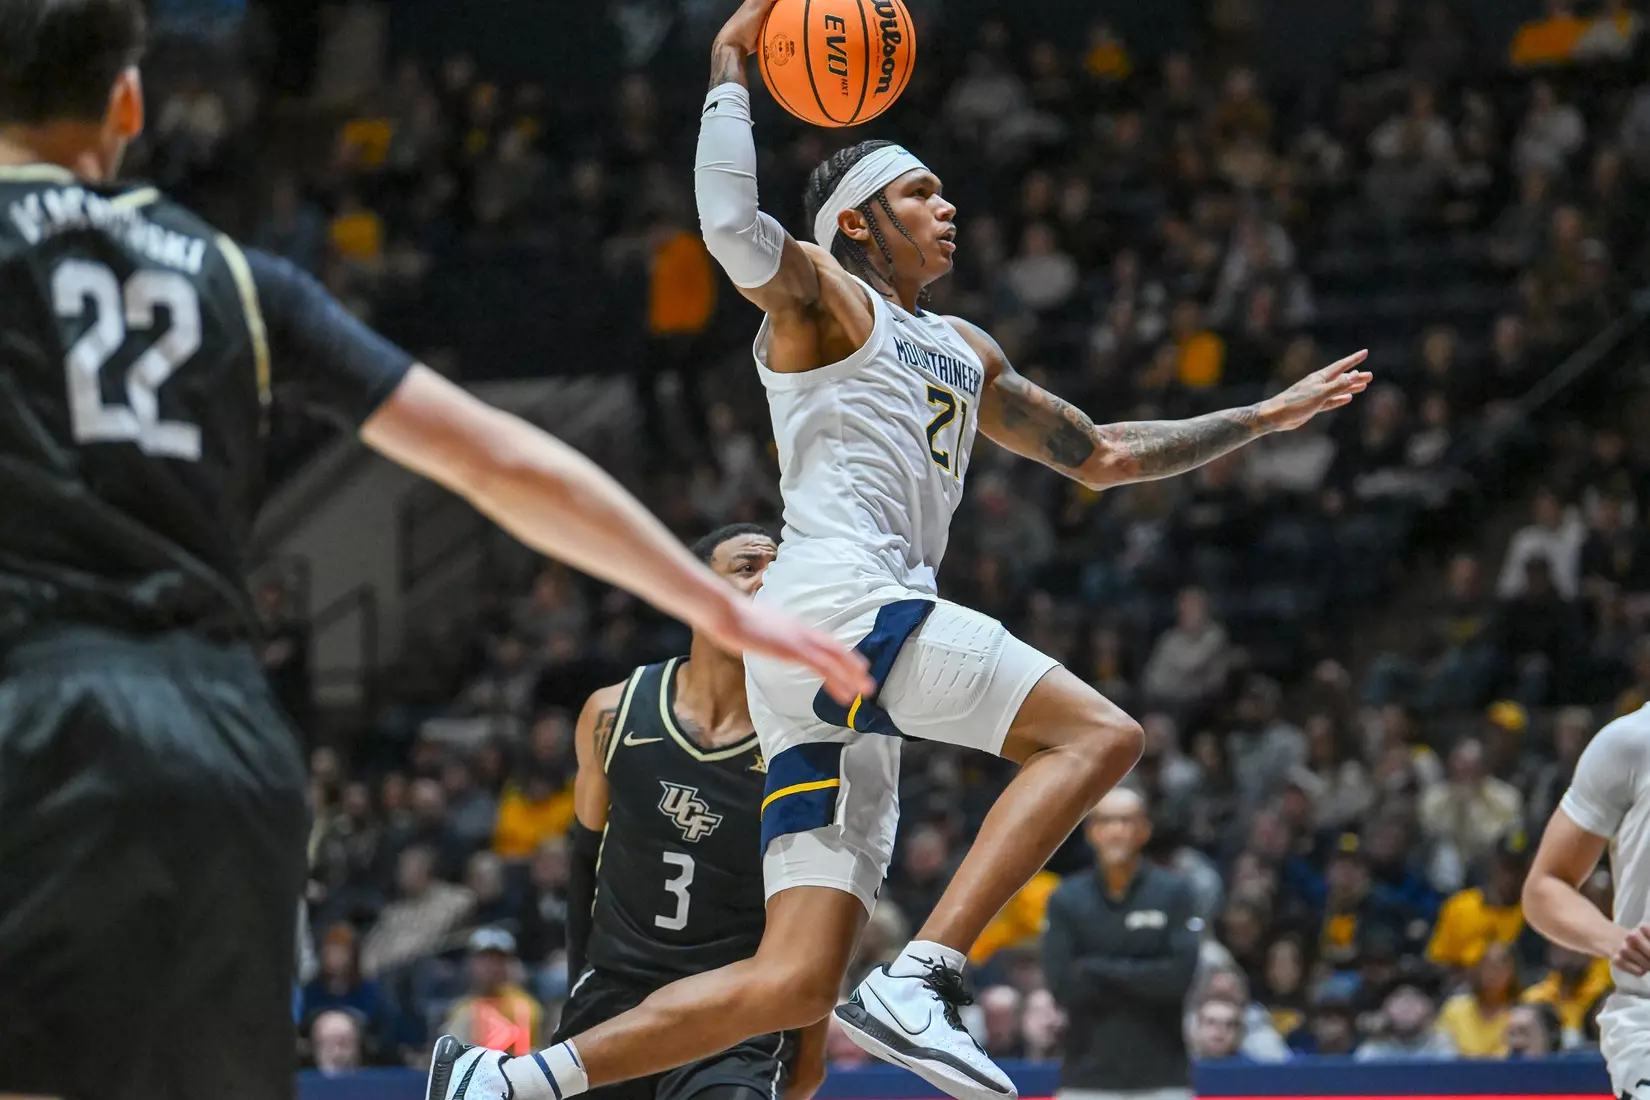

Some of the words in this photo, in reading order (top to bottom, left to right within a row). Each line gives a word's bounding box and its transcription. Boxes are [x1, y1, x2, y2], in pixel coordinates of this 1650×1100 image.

[824, 14, 849, 77] EVO
[841, 78, 849, 97] NXT
[53, 258, 202, 462] 22
[925, 383, 968, 480] 21
[659, 781, 722, 842] UCF
[655, 851, 695, 930] 3
